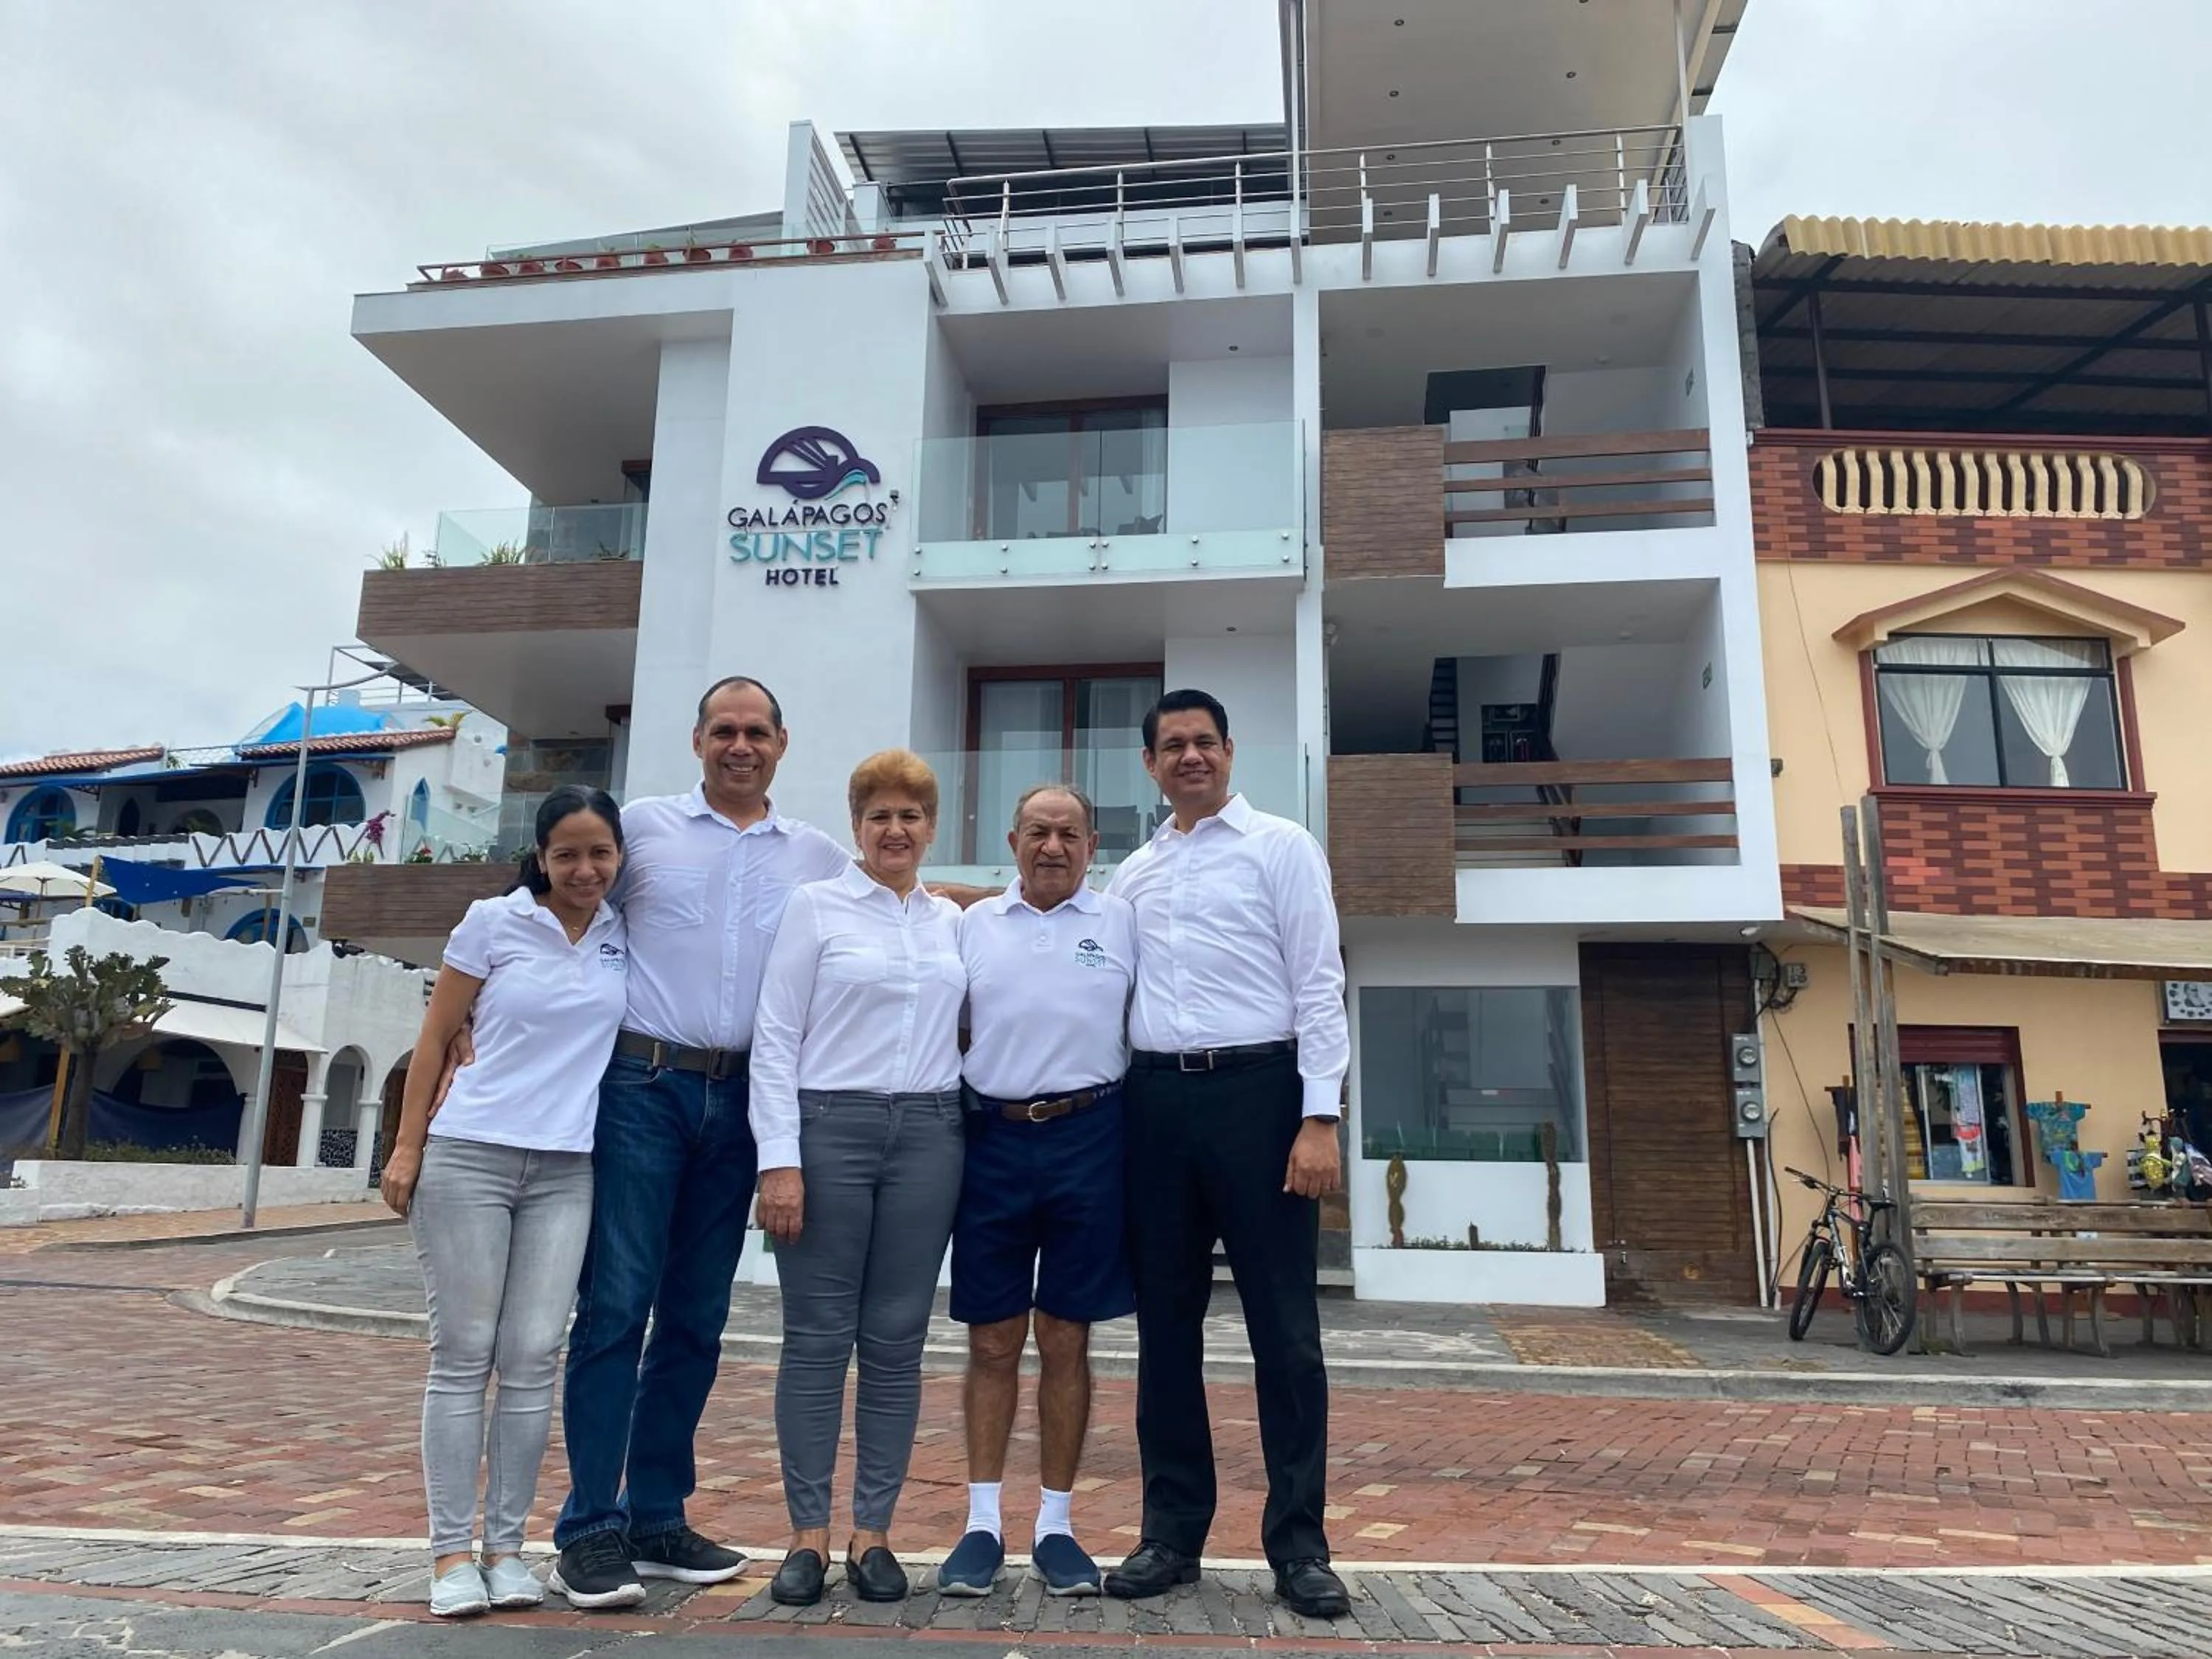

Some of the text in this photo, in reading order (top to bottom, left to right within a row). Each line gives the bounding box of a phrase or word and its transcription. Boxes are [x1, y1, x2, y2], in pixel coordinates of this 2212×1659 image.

[728, 498, 888, 527] GALÁPAGOS
[729, 528, 883, 563] SUNSET
[765, 568, 839, 585] HOTEL
